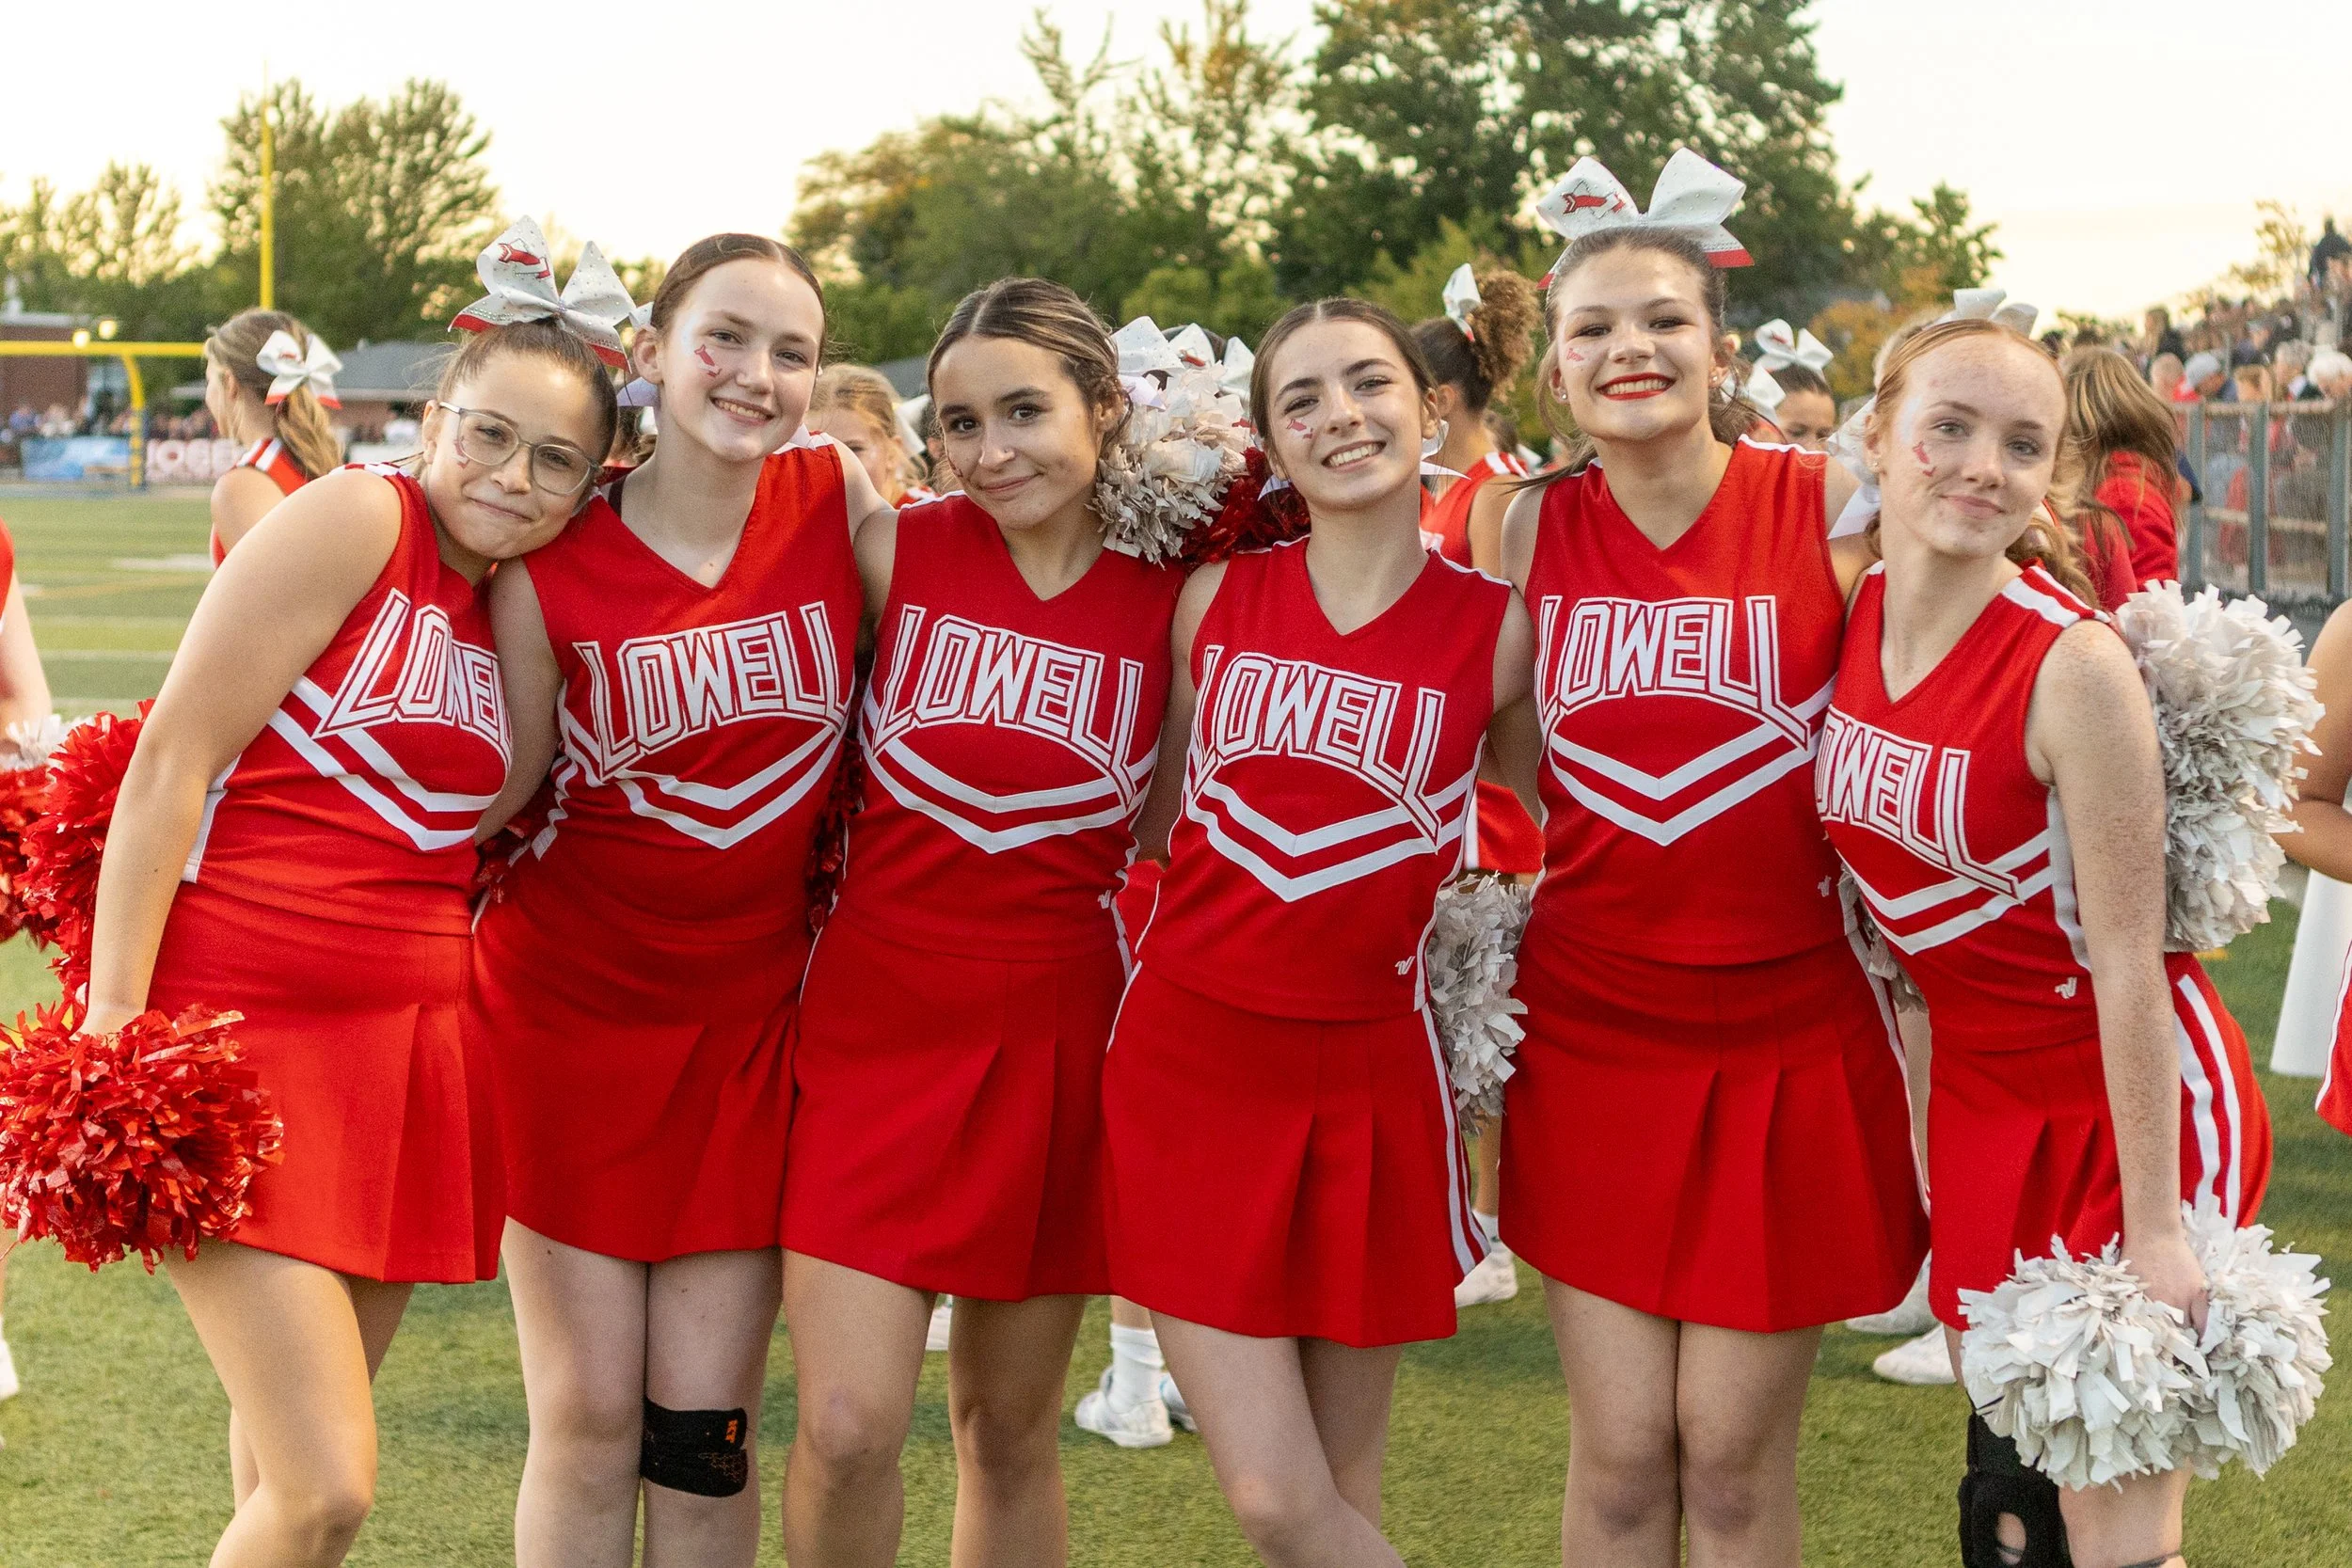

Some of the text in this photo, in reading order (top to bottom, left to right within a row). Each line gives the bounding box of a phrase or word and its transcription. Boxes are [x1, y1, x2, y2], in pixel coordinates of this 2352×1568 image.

[572, 601, 847, 782] LOWELL
[872, 604, 1143, 816] LOWELL
[1192, 644, 1445, 854] LOWELL
[1534, 595, 1811, 751] LOWELL
[1814, 704, 2025, 905] OWELL
